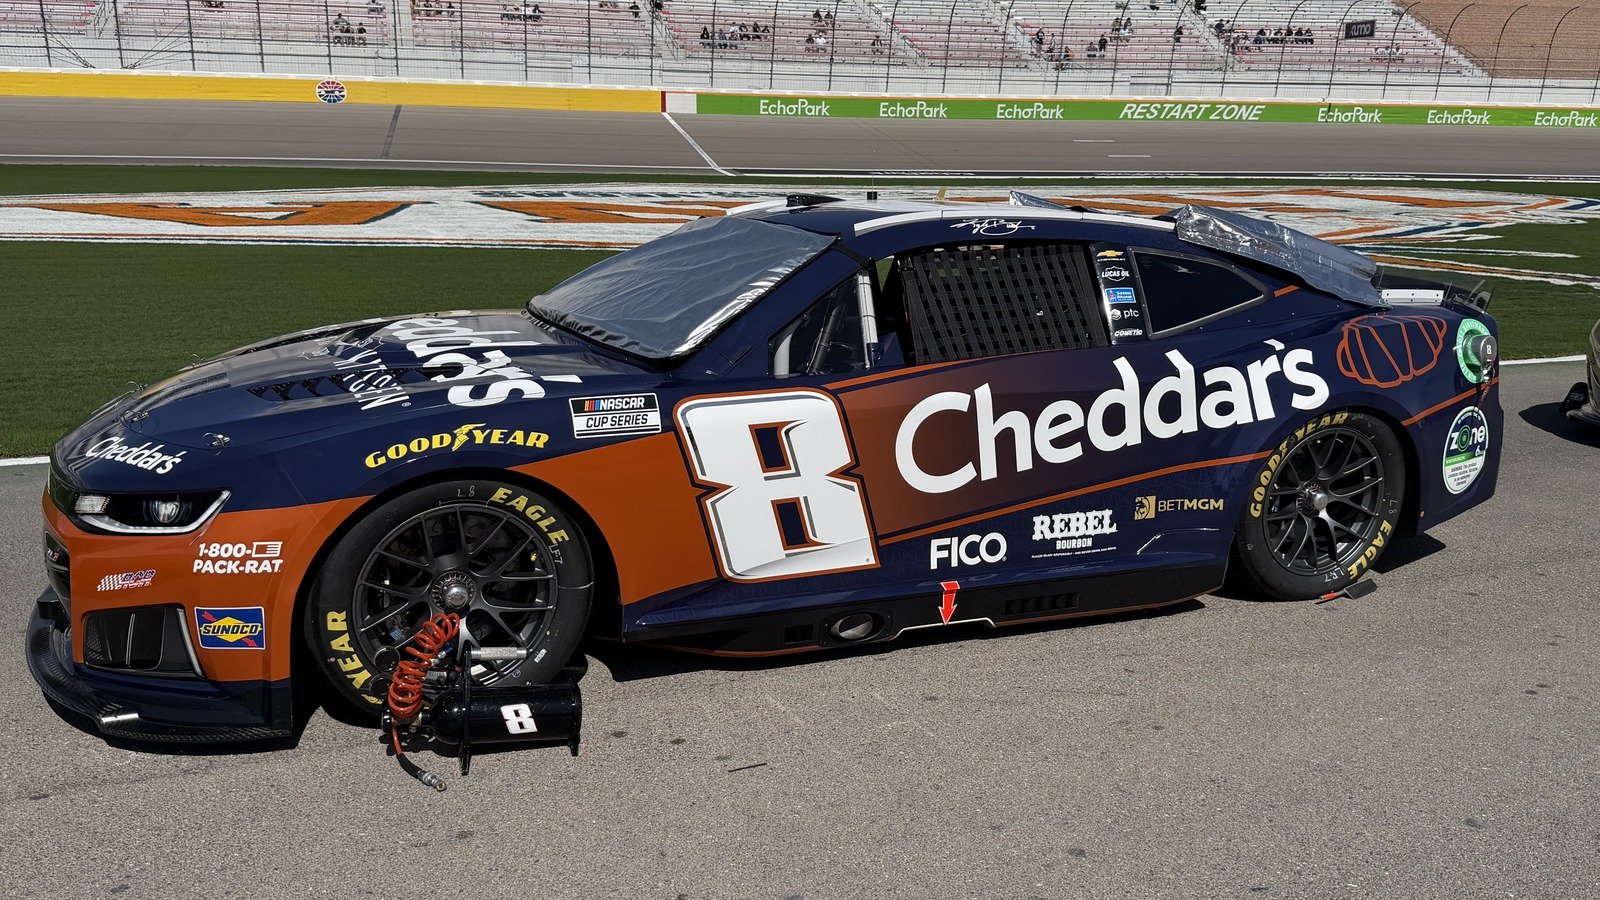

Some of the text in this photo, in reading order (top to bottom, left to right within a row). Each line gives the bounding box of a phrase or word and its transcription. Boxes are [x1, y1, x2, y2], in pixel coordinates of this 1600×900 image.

[759, 99, 831, 116] EchoPark
[879, 101, 947, 118] EchoPark
[996, 102, 1064, 119] EchoPark
[1119, 103, 1266, 120] RESTART ZONE
[1317, 106, 1383, 123] EchoPark
[1427, 108, 1490, 125] EchoPark
[1534, 110, 1598, 127] EchoPark
[1101, 269, 1130, 278] LUCAS OIL
[1123, 309, 1140, 319] ptc
[1114, 328, 1143, 337] COMETIC
[599, 397, 645, 410] NASCAR
[586, 413, 649, 429] CUP SERIES
[895, 338, 1331, 494] Cheddar's
[85, 436, 187, 474] Cheddar's
[675, 389, 879, 582] 8
[490, 487, 570, 546] EAGLE
[1031, 508, 1118, 541] REBEL
[930, 532, 1007, 570] FICO
[1056, 537, 1093, 550] BOURBON
[1347, 519, 1393, 579] EAGLE
[193, 559, 283, 574] PACK-RAT
[202, 623, 261, 635] SUNOCO
[500, 703, 538, 734] 8
